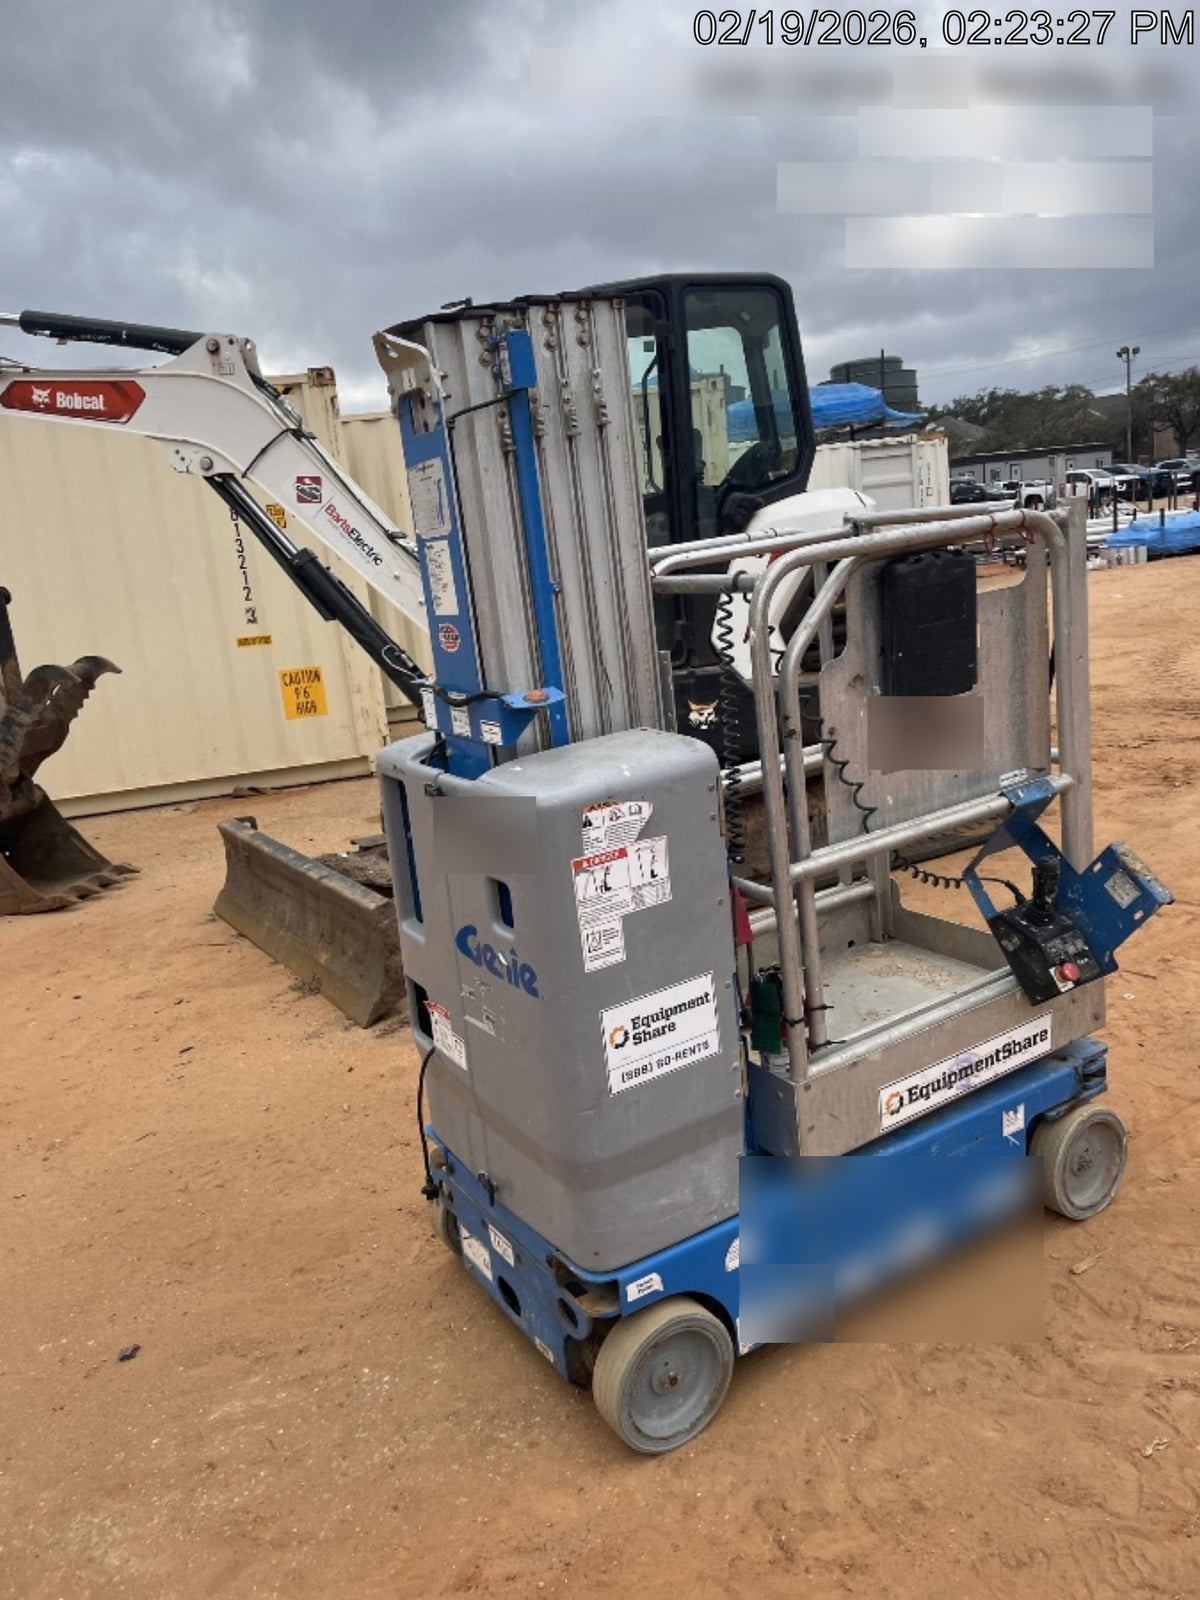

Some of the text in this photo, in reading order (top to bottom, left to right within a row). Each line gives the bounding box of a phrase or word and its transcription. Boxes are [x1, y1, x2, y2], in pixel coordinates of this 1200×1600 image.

[56, 391, 105, 410] Bobcat
[282, 669, 321, 687] CAUTION
[455, 924, 540, 998] Genie
[631, 992, 710, 1031] Equipment
[632, 1022, 677, 1046] Share
[906, 1028, 1048, 1102] EquipmentShare
